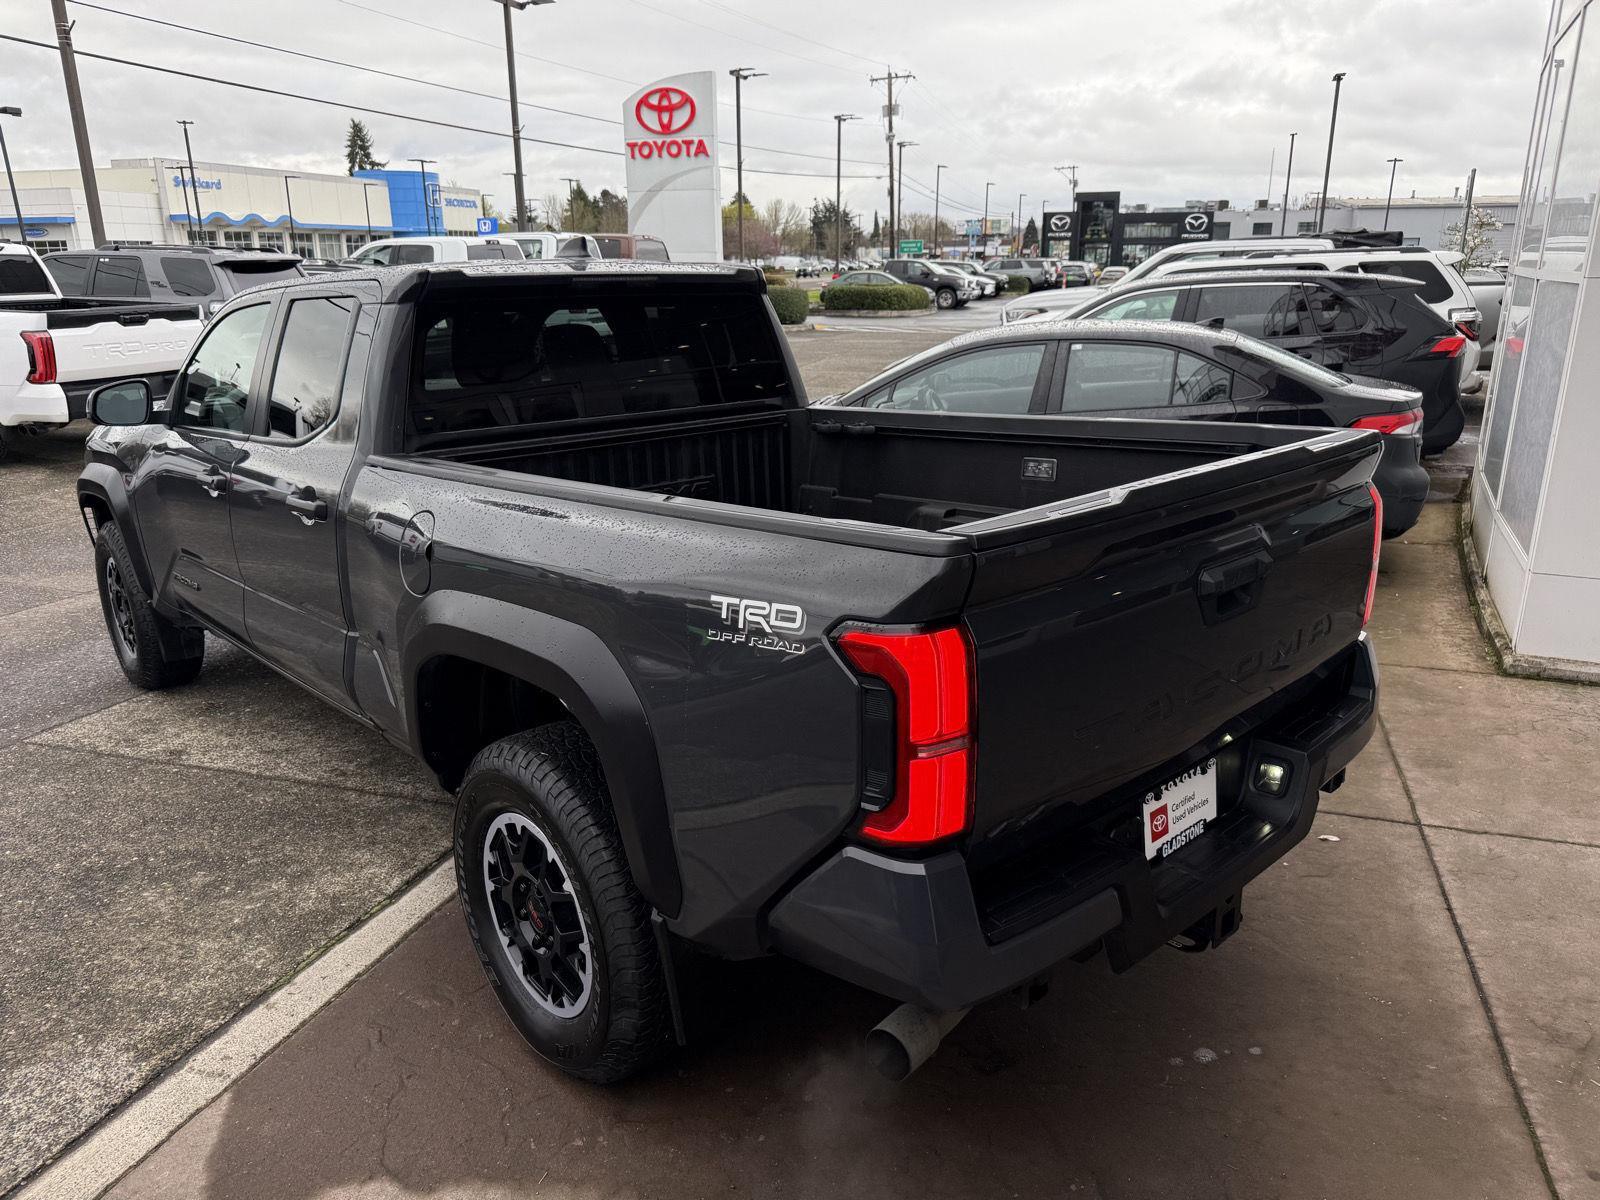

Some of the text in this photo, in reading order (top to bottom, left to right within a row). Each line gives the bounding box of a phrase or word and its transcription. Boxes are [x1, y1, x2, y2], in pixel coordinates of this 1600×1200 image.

[626, 139, 709, 160] TOYOTA
[82, 340, 188, 360] TRD PRO
[710, 594, 806, 635] TRD
[707, 628, 806, 655] OFF ROAD
[1160, 765, 1202, 795] TOYOTA
[1171, 790, 1196, 813] Certified
[1172, 797, 1209, 825] Used Vehicles
[1162, 820, 1205, 858] GLADSTONE
